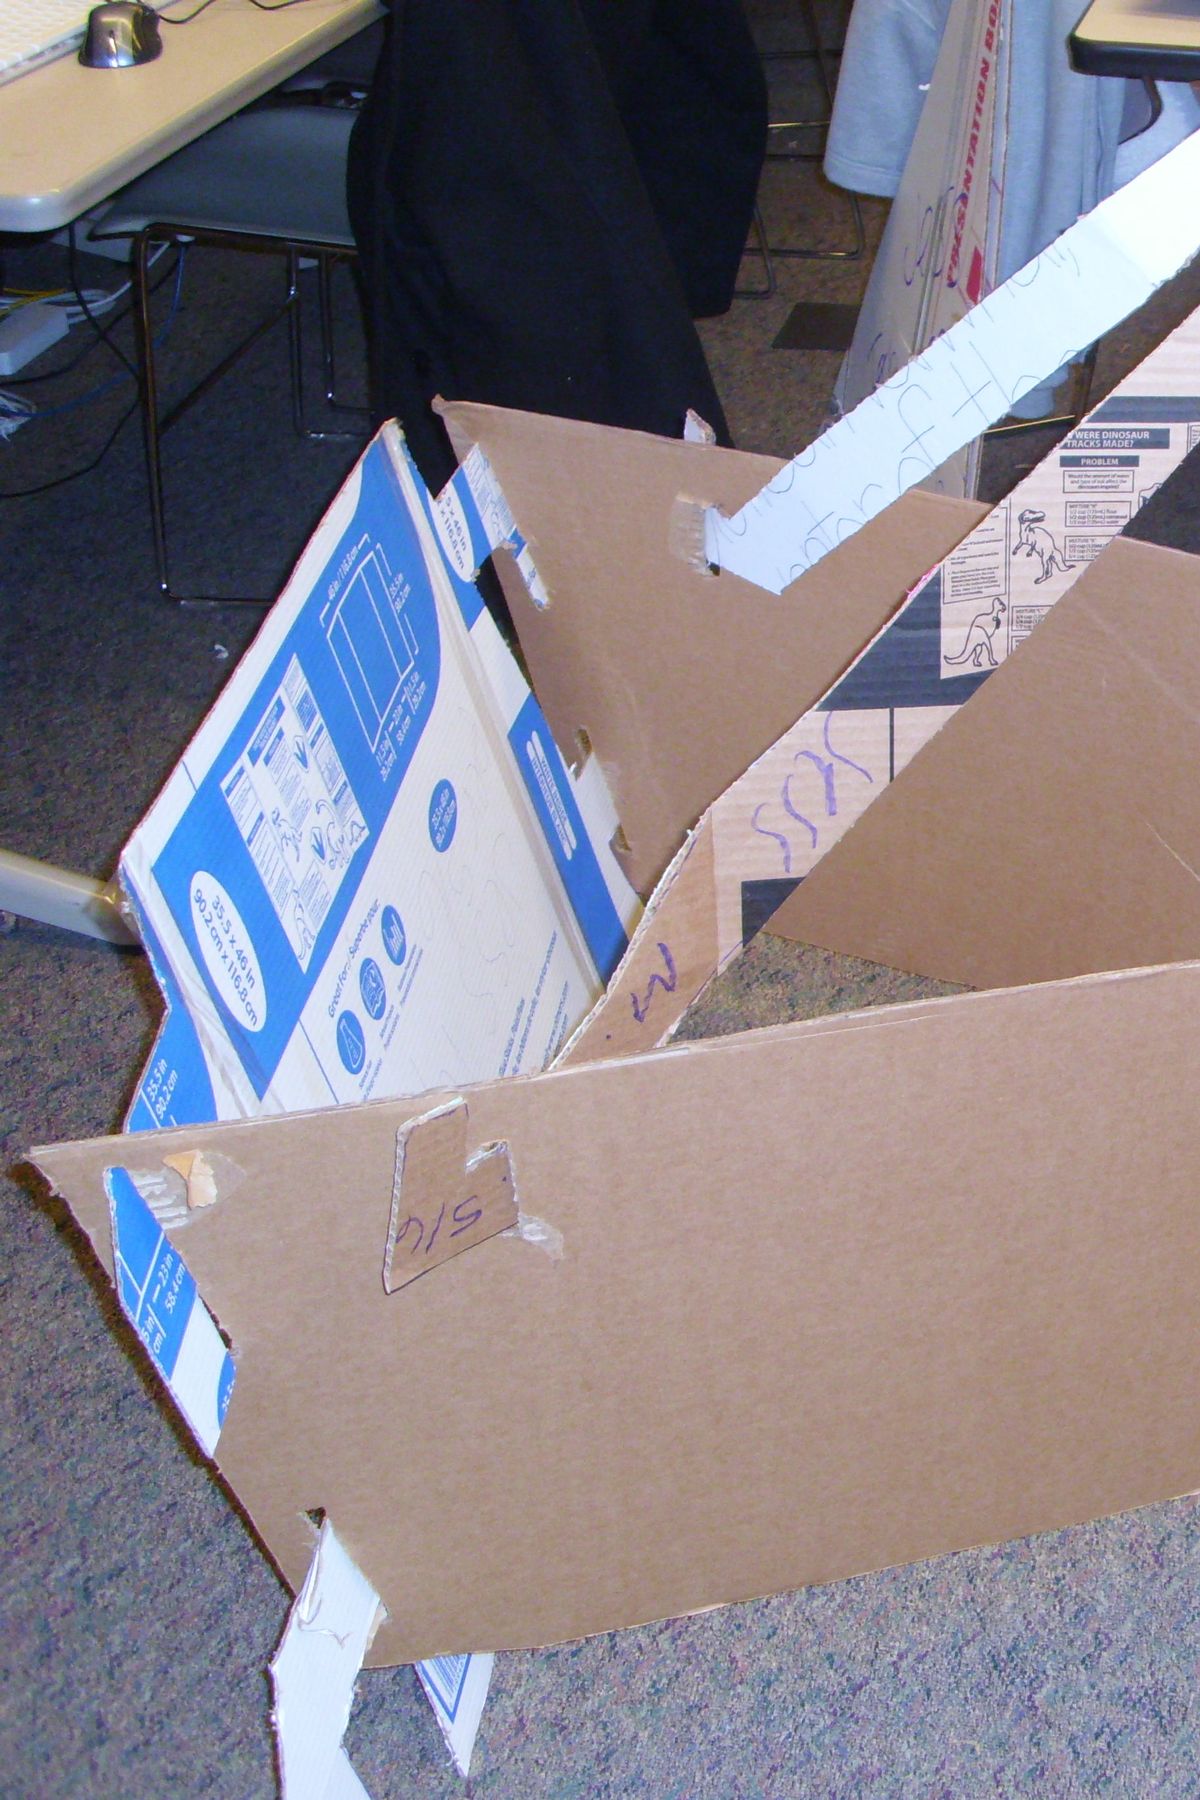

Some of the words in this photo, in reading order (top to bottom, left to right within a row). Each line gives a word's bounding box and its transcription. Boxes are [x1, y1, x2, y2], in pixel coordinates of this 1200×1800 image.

[1066, 440, 1101, 448] TRACKS
[1102, 440, 1135, 448] MADE?
[1075, 431, 1101, 440] WERE
[1102, 431, 1150, 440] DINOSAUR
[1081, 458, 1119, 466] PROBLEM
[211, 895, 233, 935] 35.5
[235, 949, 249, 971] 46
[193, 888, 213, 928] 90.2
[210, 926, 223, 952] cm
[227, 960, 248, 1003] 116.8
[245, 1001, 258, 1027] cm
[147, 1068, 163, 1102] 35.5
[157, 1058, 168, 1075] in
[156, 1085, 172, 1120] 90.2
[167, 1069, 178, 1092] cm
[158, 1265, 169, 1287] 23
[163, 1253, 174, 1272] in
[165, 1279, 179, 1315] 58.4
[175, 1262, 186, 1286] cm
